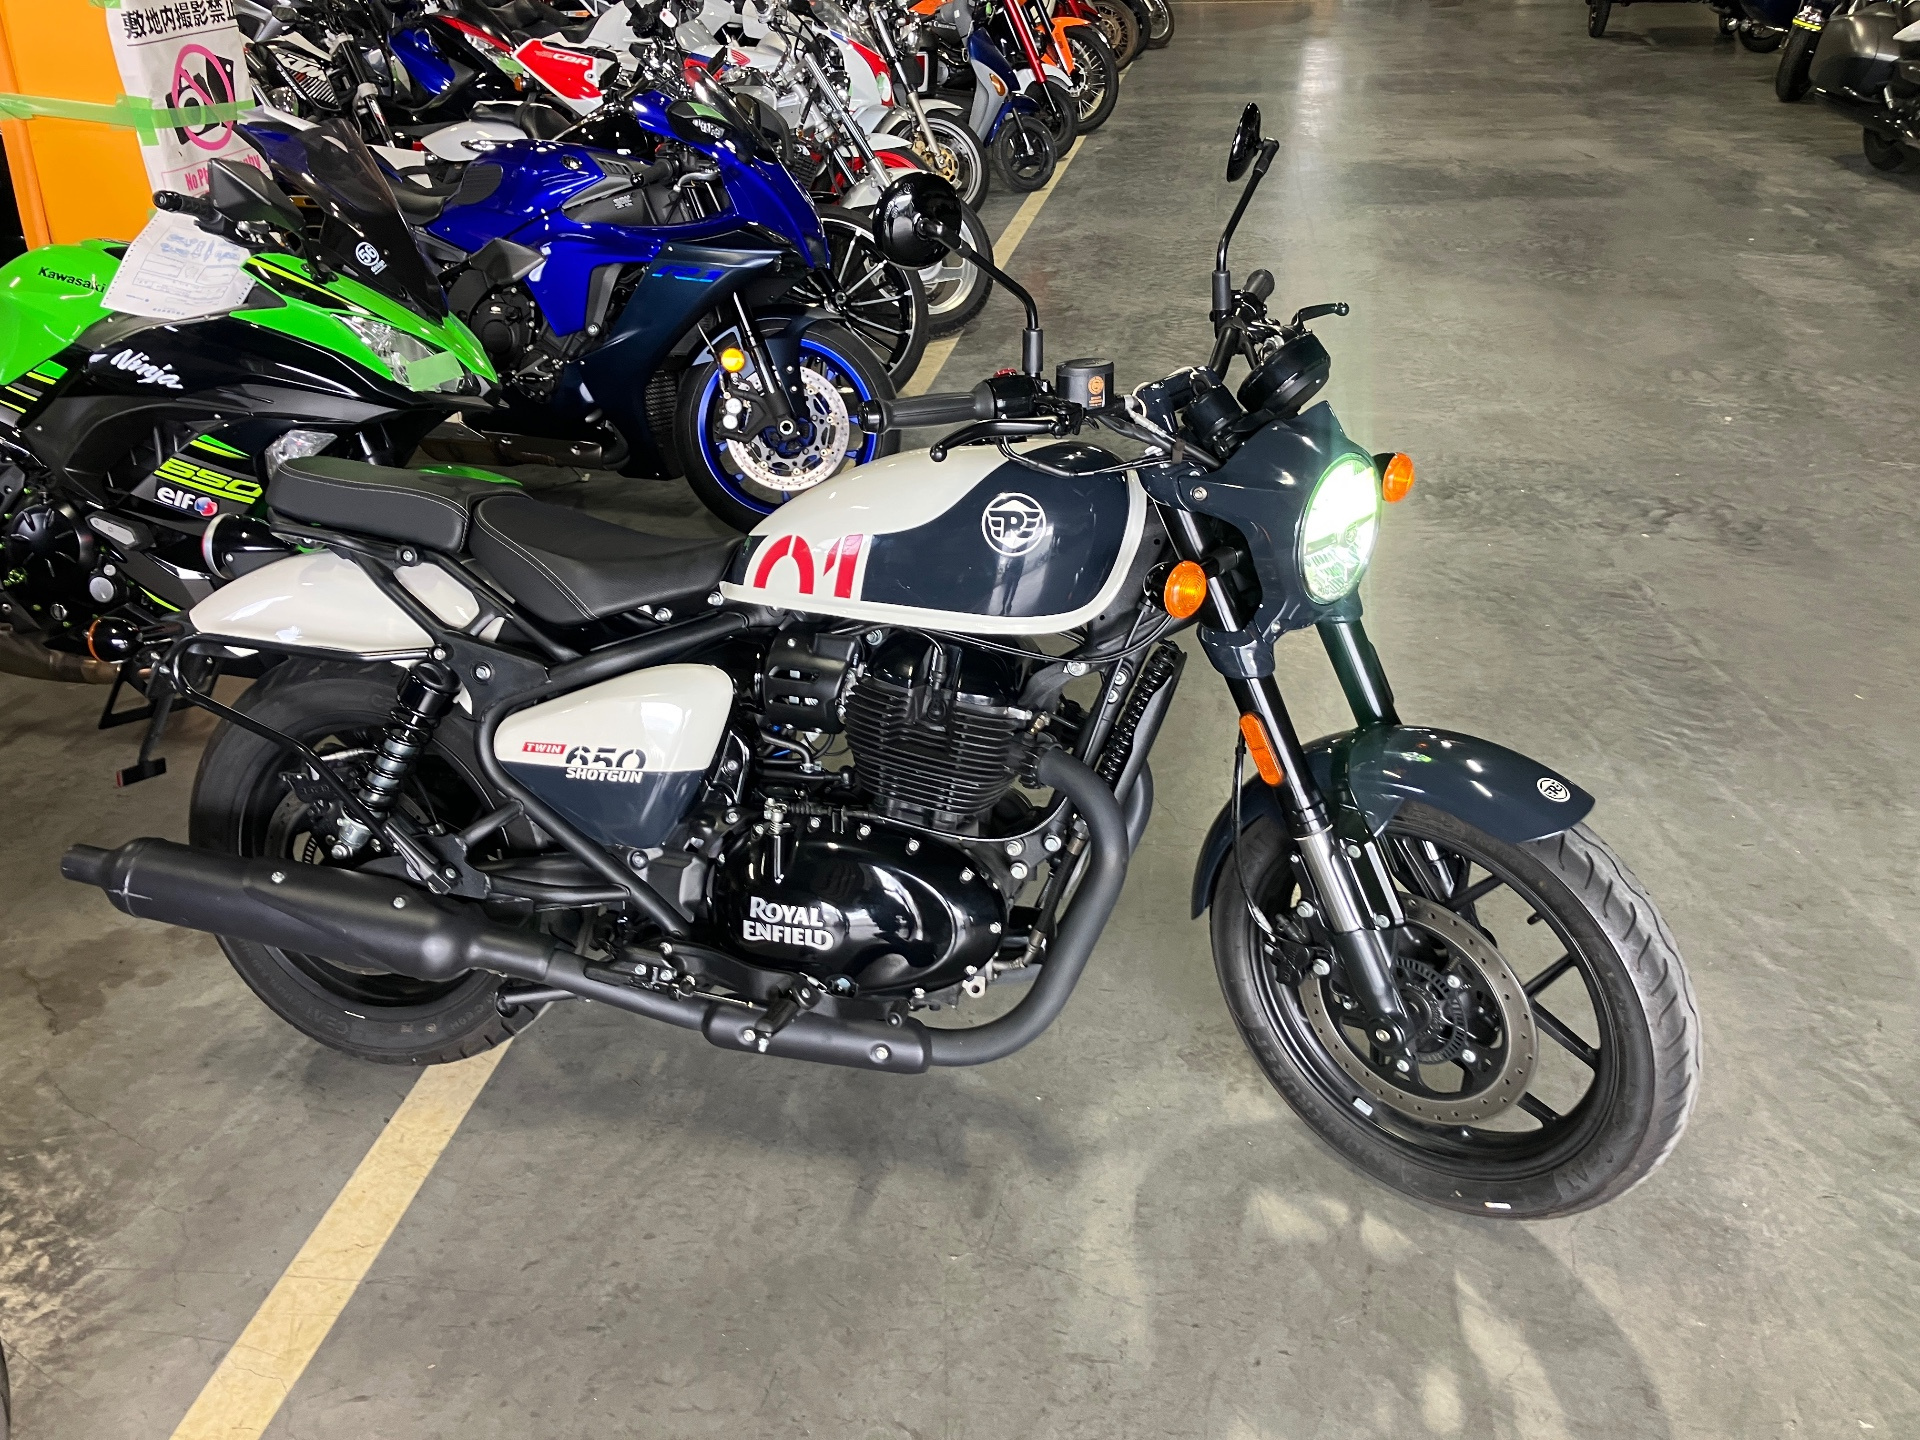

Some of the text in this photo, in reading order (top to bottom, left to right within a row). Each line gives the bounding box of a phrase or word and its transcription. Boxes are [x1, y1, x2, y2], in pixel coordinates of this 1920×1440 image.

[553, 53, 590, 67] CBR
[184, 171, 199, 192] No
[358, 244, 378, 263] 56
[37, 266, 107, 294] Kawasaki
[110, 348, 185, 390] Ninja
[159, 456, 264, 498] 650
[156, 485, 196, 510] elf
[526, 742, 562, 754] TWIN
[565, 745, 647, 770] 650
[565, 767, 644, 784] SHOTGUN
[749, 895, 824, 928] ROYAL
[742, 919, 834, 951] ENFIELD
